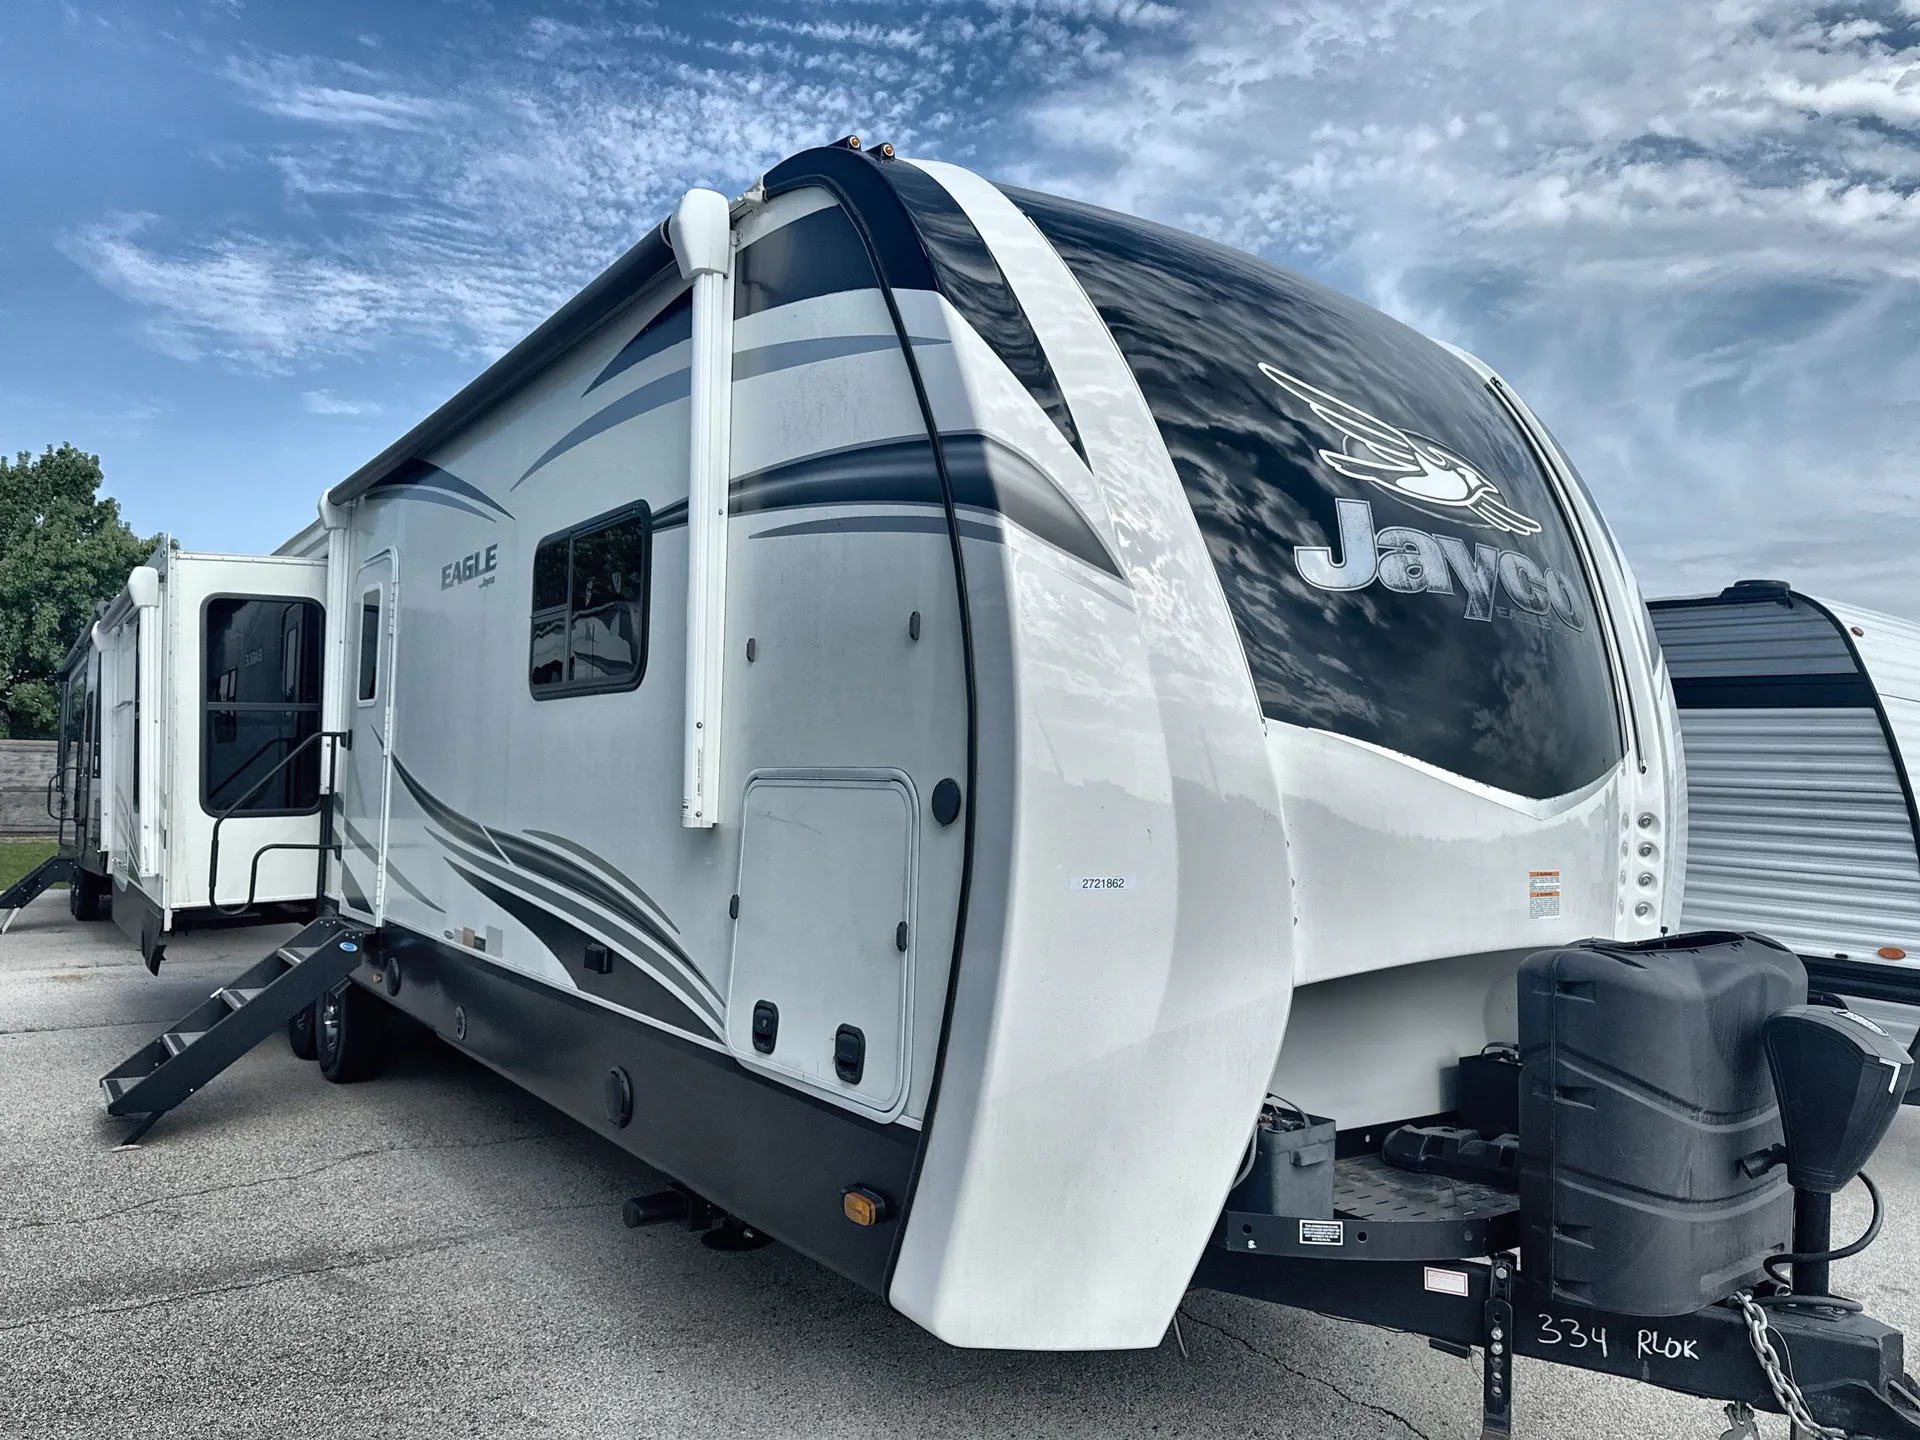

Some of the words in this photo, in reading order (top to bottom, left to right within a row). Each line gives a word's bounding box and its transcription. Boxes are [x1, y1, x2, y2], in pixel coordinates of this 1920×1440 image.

[441, 542, 498, 591] EAGLE
[1293, 497, 1586, 632] Jayco
[1082, 878, 1125, 889] 2721862
[1537, 1313, 1608, 1358] 334
[1637, 1329, 1700, 1361] RLOK
